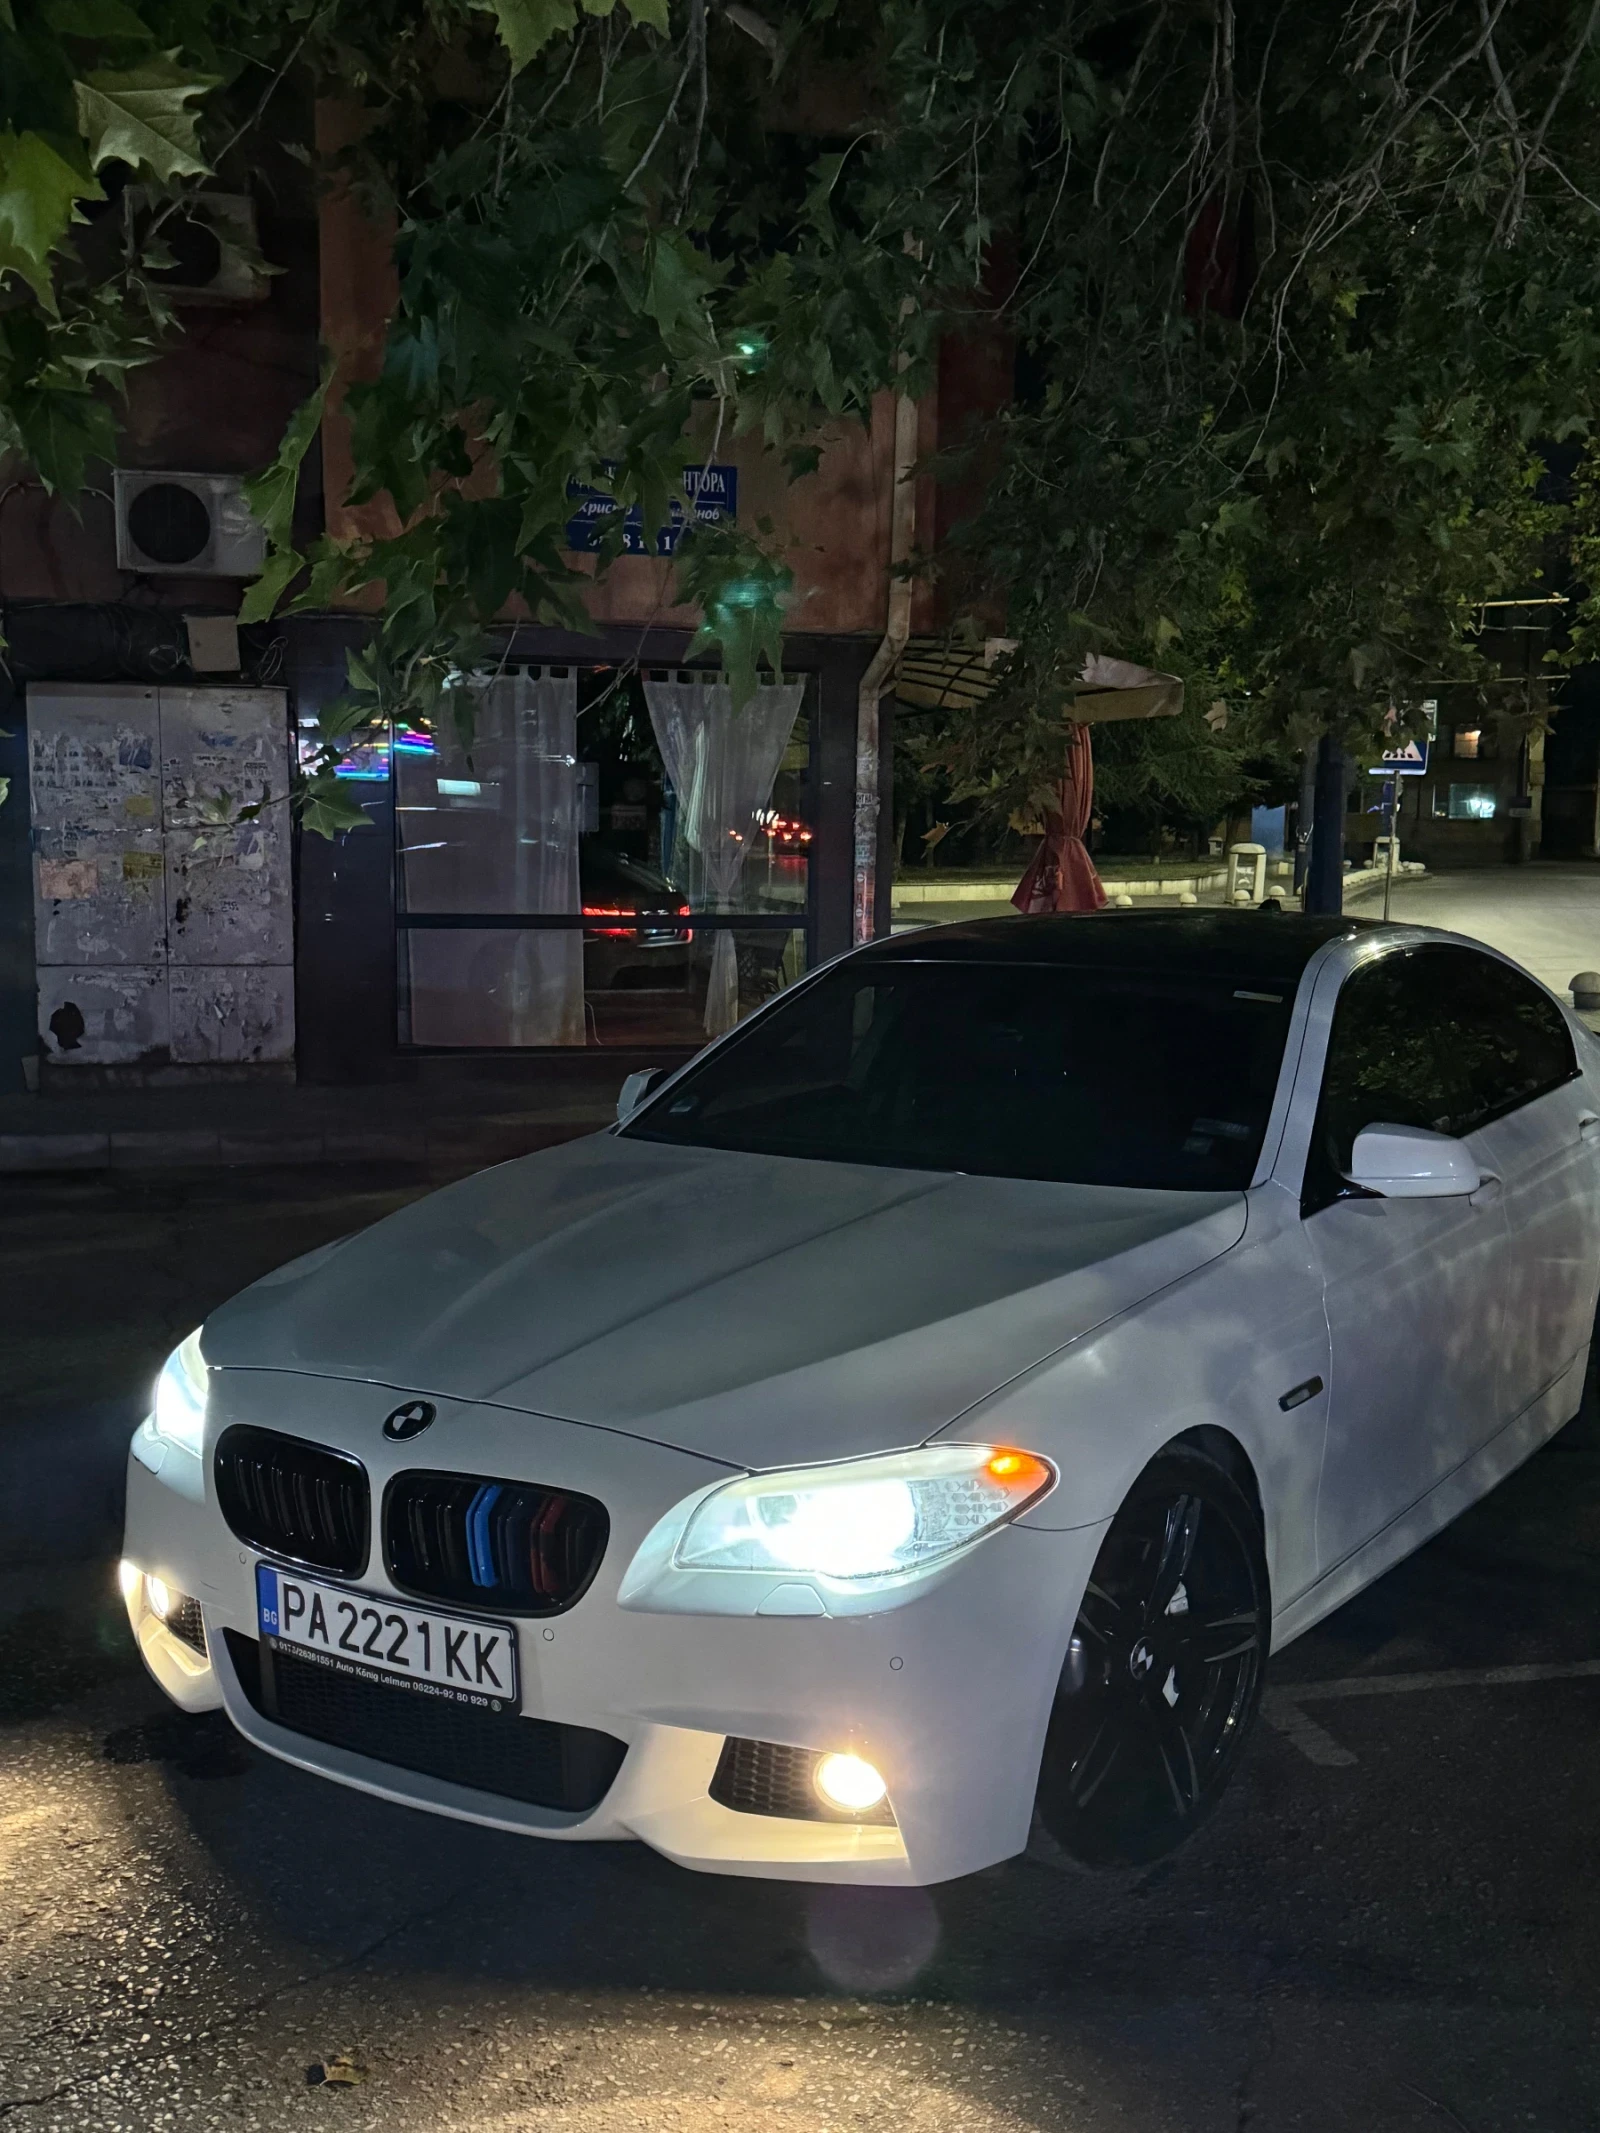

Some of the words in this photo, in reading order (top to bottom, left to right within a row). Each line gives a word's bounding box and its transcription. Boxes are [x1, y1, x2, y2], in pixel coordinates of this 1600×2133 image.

[263, 1607, 278, 1626] BG
[336, 1660, 354, 1674] Auto
[355, 1666, 379, 1683] König
[456, 1691, 469, 1703] 80
[471, 1695, 488, 1707] 929
